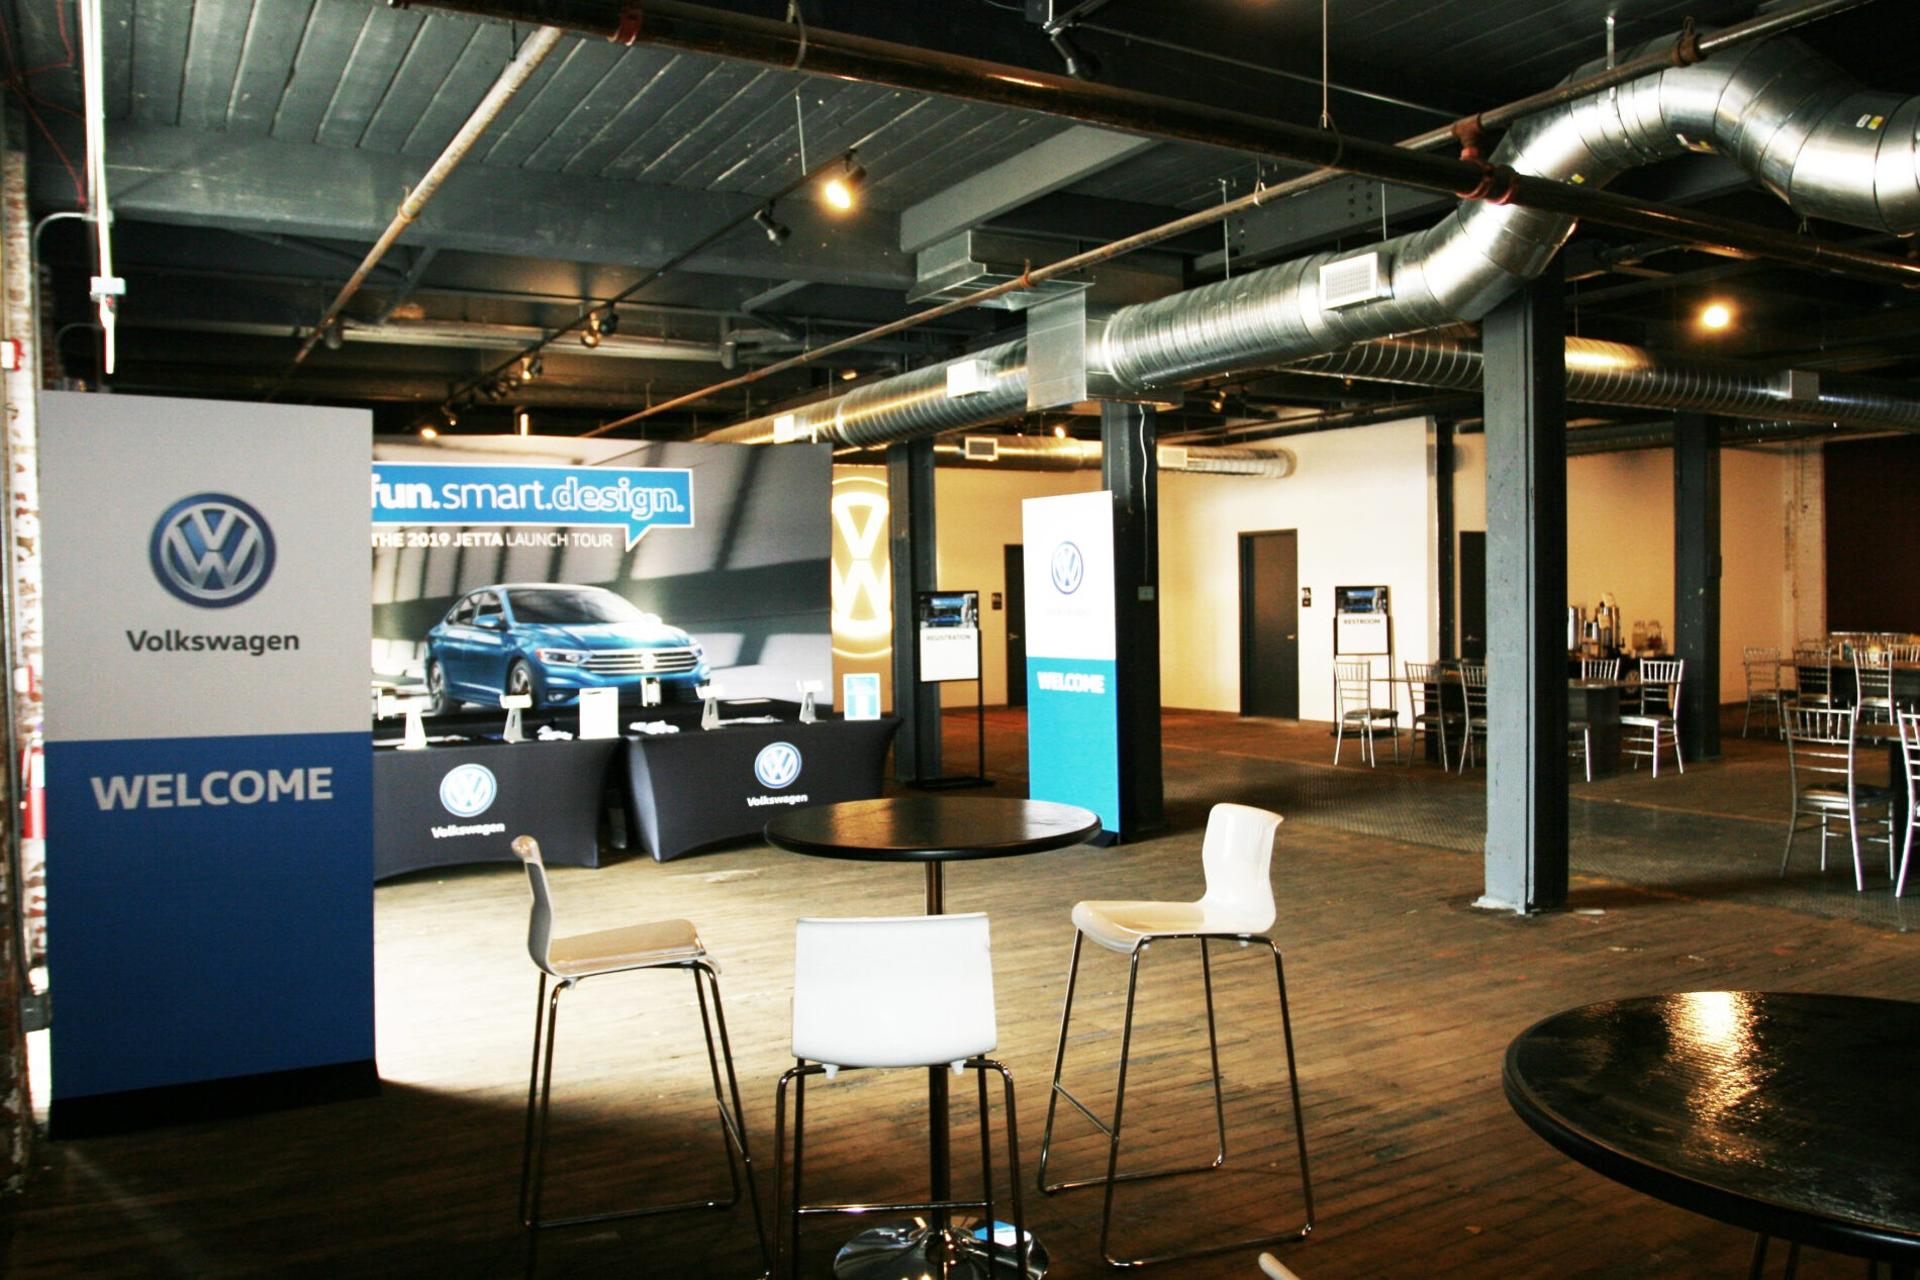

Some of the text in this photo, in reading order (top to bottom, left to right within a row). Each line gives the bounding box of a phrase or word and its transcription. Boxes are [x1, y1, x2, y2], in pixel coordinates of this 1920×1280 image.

[371, 473, 685, 521] fun.smart.design.
[158, 501, 267, 600] VW
[371, 532, 613, 548] THE 2019 JETTA LAUNCH TOUR
[126, 630, 300, 657] Volkswagen
[1037, 671, 1105, 694] WELCOME
[90, 766, 334, 812] WELCOME
[746, 794, 809, 807] Volkswagen
[431, 823, 506, 839] Volkswagen
